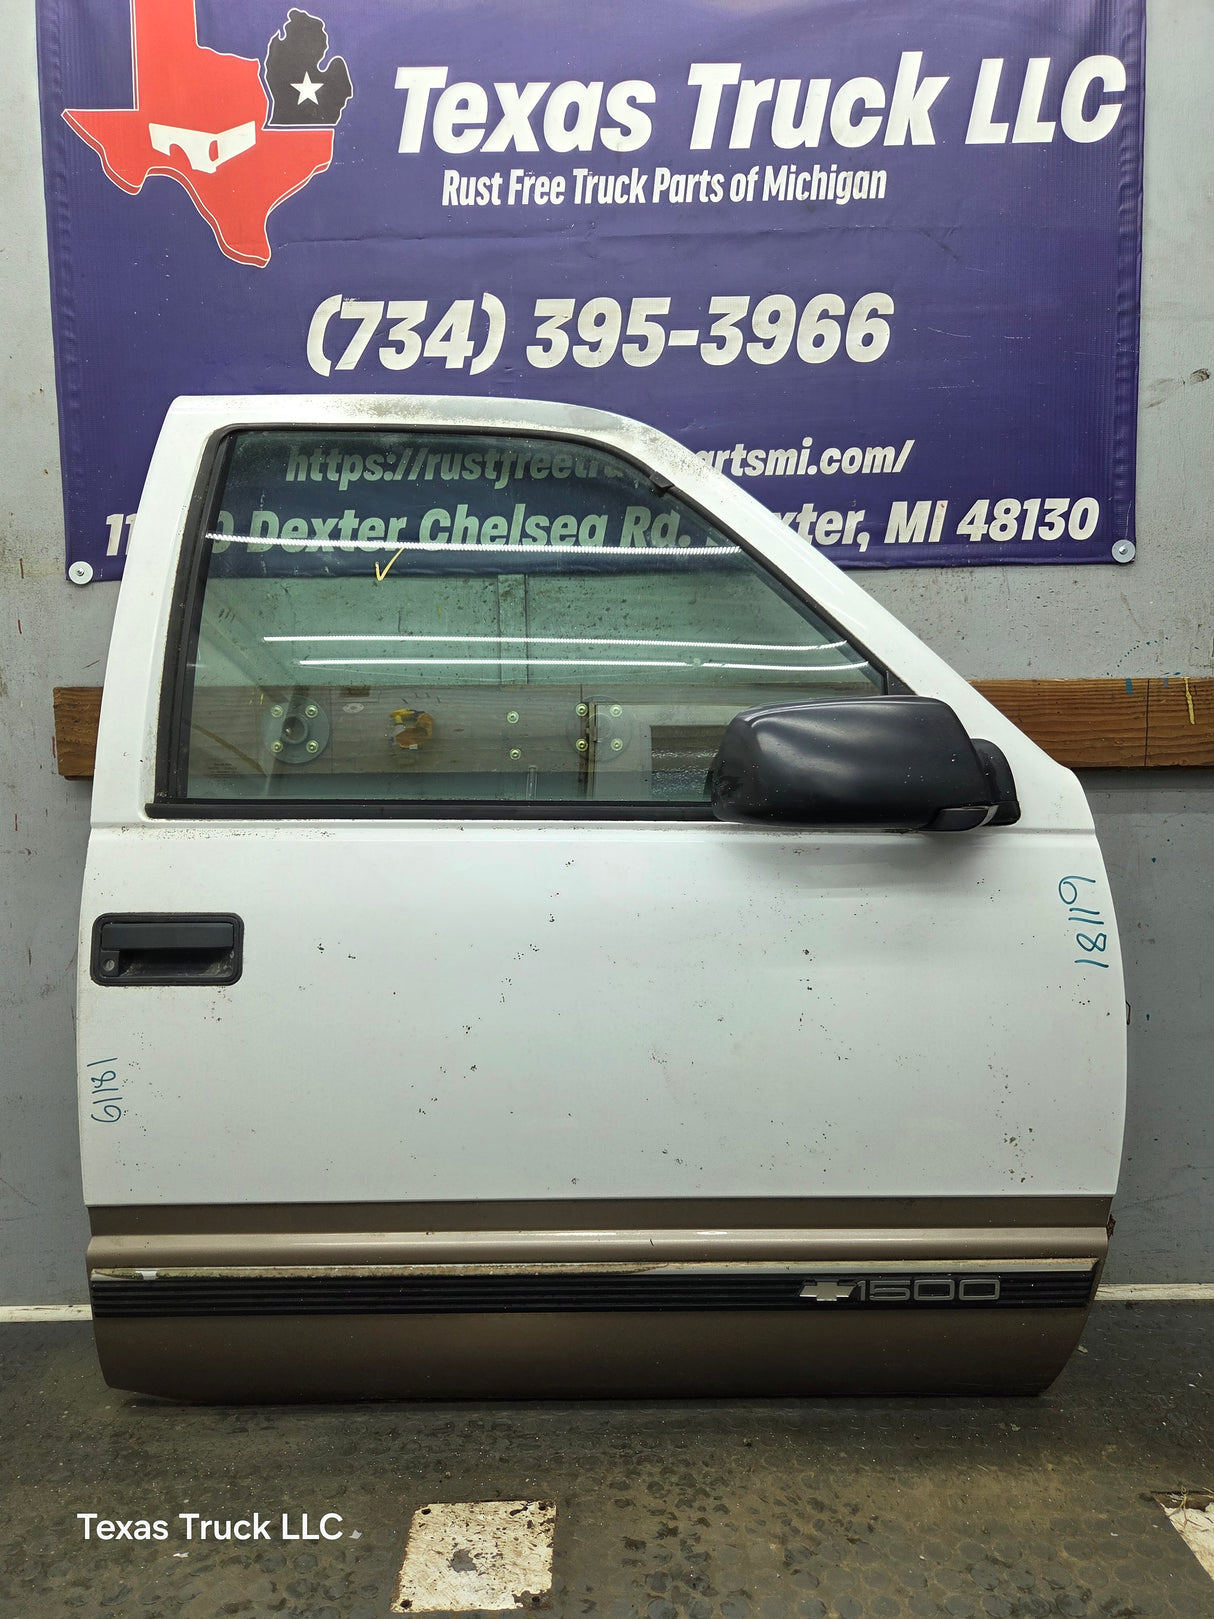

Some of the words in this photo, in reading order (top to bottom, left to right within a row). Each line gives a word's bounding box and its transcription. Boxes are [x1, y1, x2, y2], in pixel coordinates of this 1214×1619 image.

[394, 66, 656, 154] Texas
[688, 51, 951, 150] Truck
[965, 55, 1127, 144] LLC
[442, 169, 503, 206] Rust
[508, 169, 566, 205] Free
[573, 168, 648, 204] Truck
[652, 167, 726, 203] Parts
[730, 166, 759, 202] of
[762, 164, 887, 206] Michigan
[307, 292, 507, 377] (734)
[526, 292, 895, 368] 395-3966
[250, 508, 408, 553] Dexter
[418, 504, 609, 552] Chelsea
[619, 505, 692, 548] Rd.
[884, 501, 948, 544] MI
[957, 497, 1100, 541] 48130
[855, 1279, 1001, 1301] 1500
